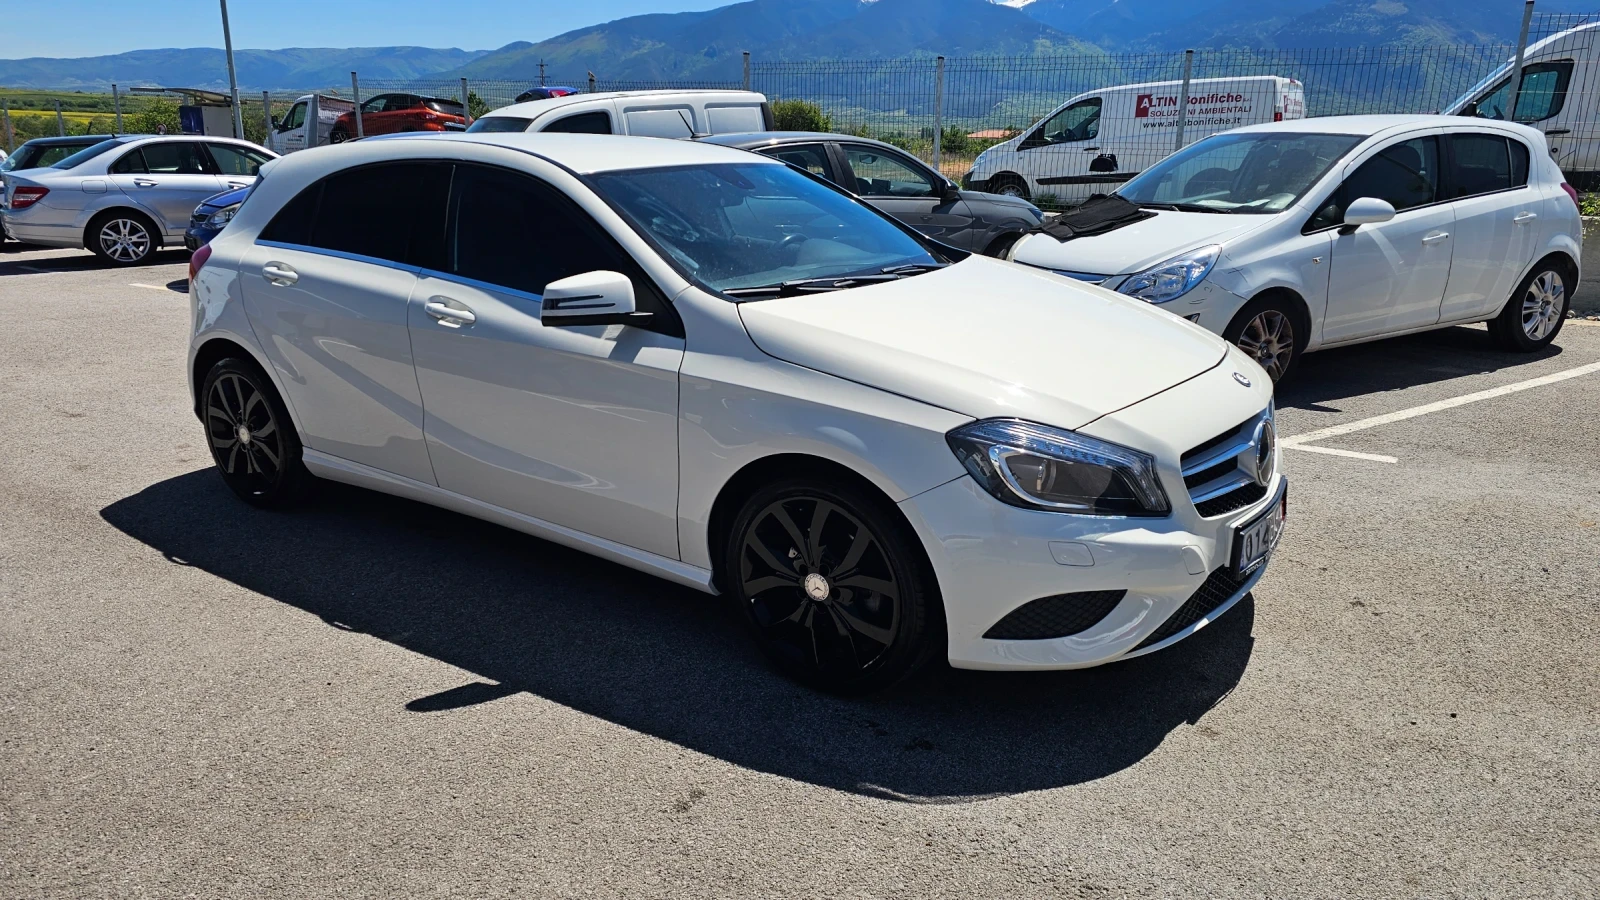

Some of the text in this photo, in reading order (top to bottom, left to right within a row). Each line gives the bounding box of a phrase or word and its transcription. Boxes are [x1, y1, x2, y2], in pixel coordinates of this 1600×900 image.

[1140, 96, 1178, 108] ALTIN
[1150, 106, 1252, 117] SOLUZINI AMBIENTALI
[1143, 117, 1241, 128] www.altbonifiche.it
